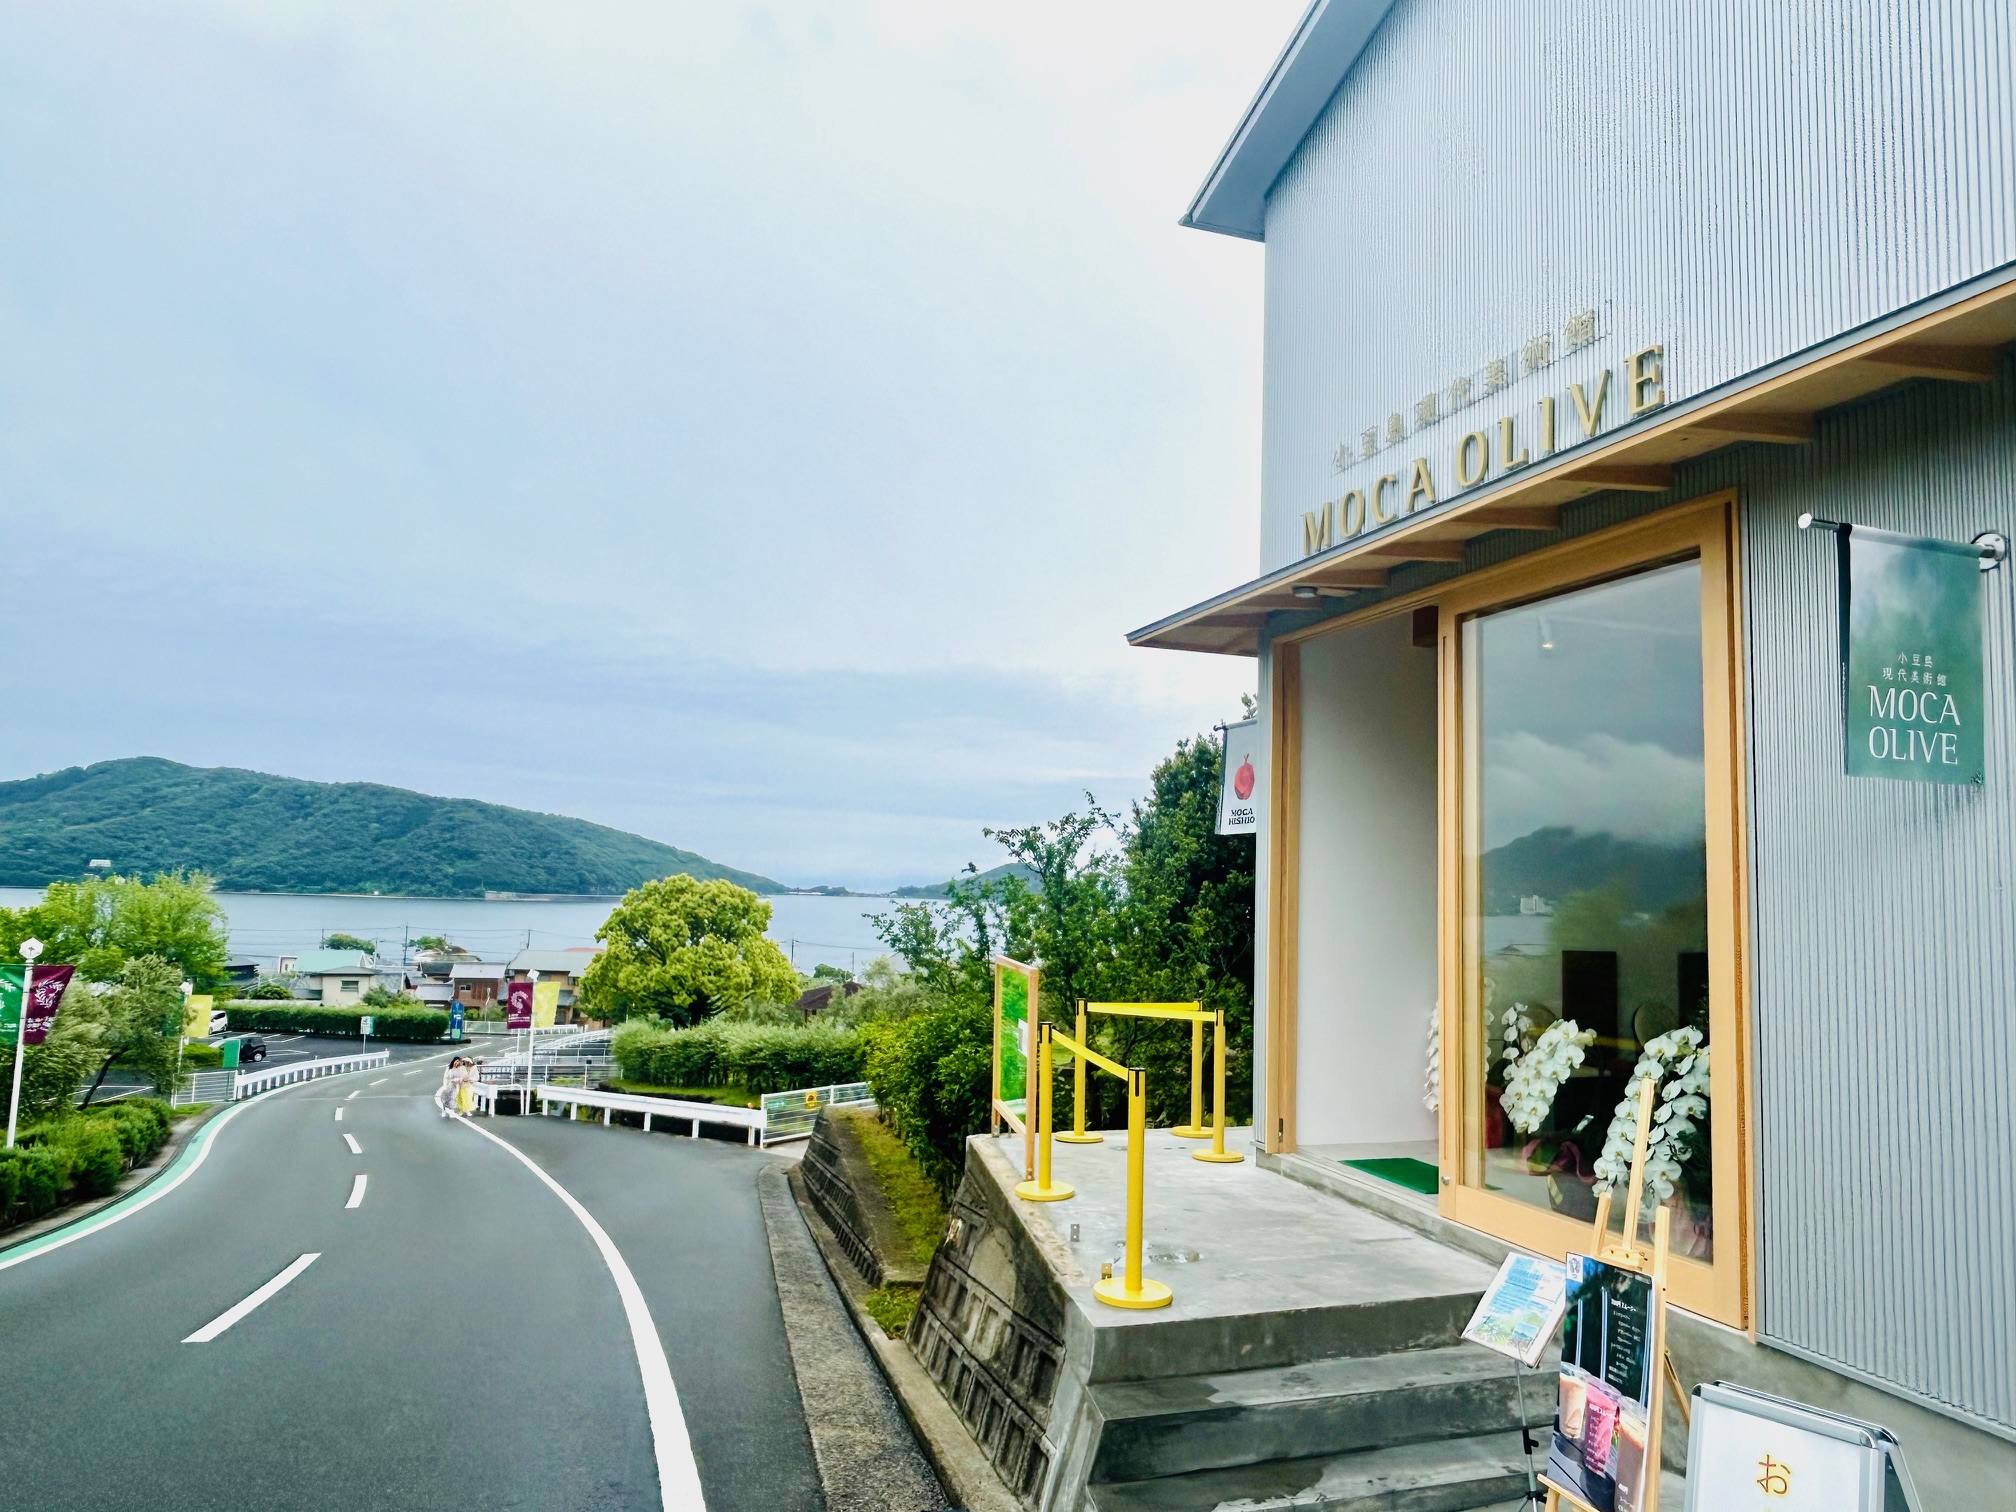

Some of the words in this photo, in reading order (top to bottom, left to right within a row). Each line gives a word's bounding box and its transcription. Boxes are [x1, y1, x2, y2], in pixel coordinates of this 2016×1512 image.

[1302, 457, 1436, 556] MOCA
[1456, 344, 1665, 487] OLIVE
[1882, 667, 1947, 686] 現代美術館
[1868, 685, 1961, 726] MOCA
[1869, 726, 1958, 765] OLIVE
[1228, 816, 1255, 825] HISHIO
[1231, 807, 1253, 817] MOCA
[1756, 1454, 1791, 1495] お
